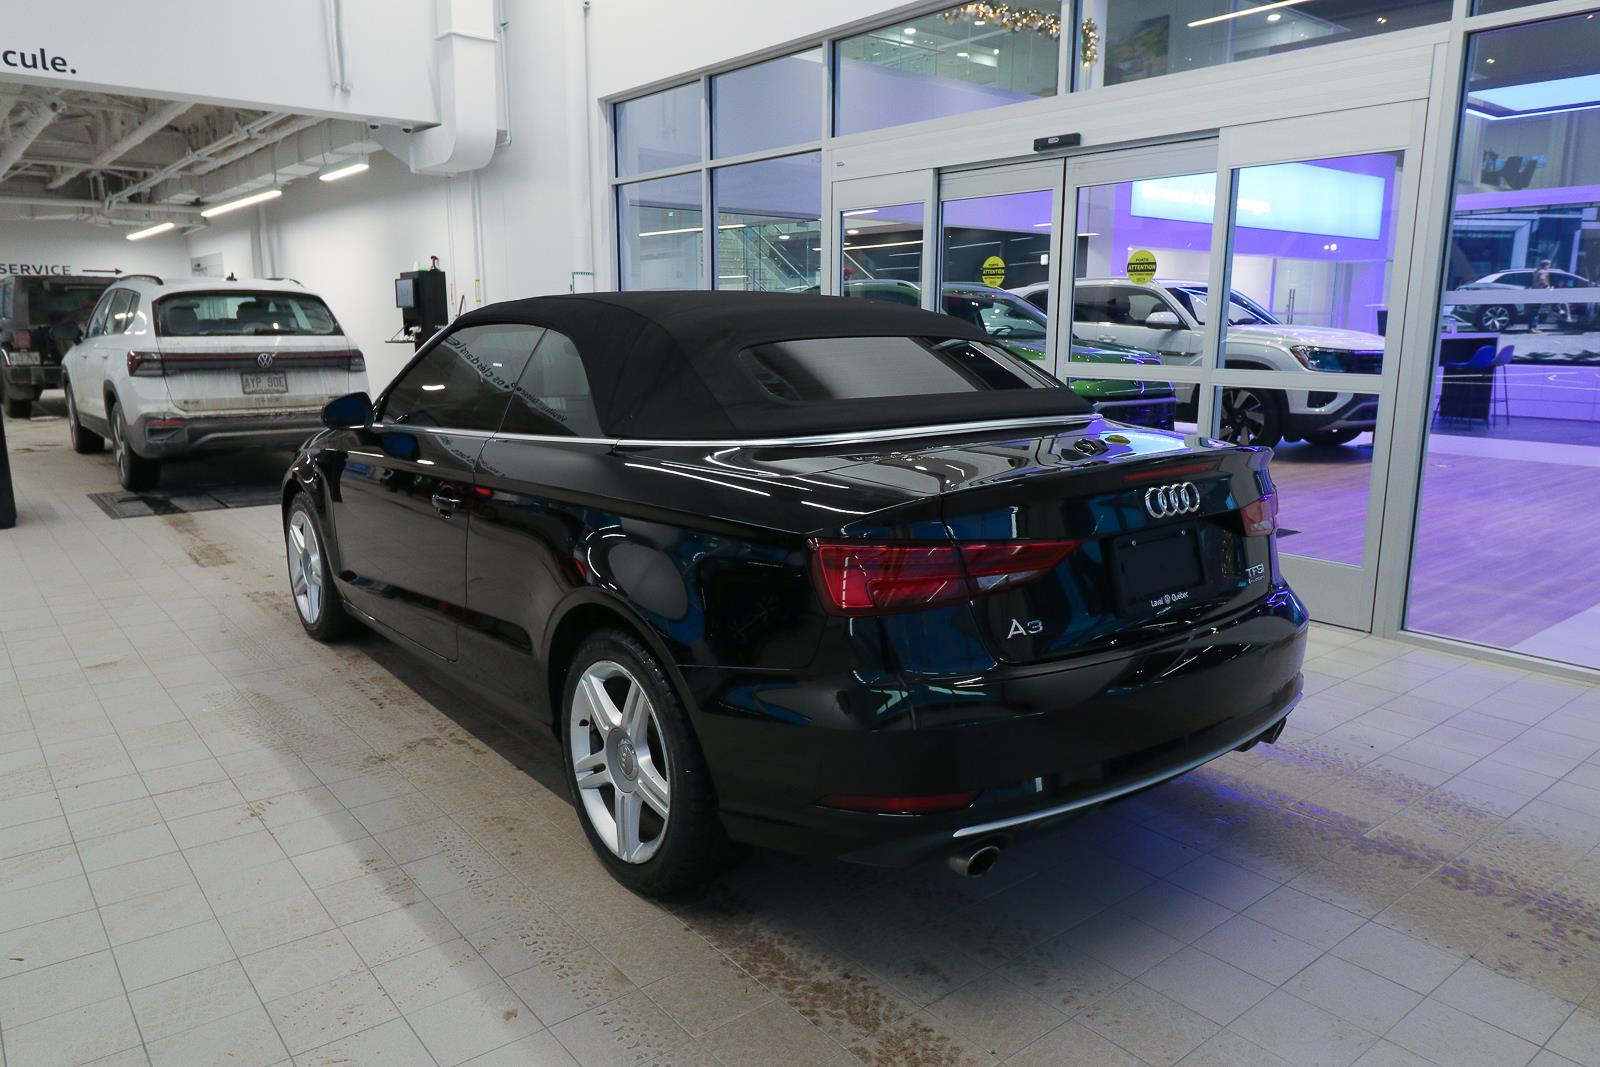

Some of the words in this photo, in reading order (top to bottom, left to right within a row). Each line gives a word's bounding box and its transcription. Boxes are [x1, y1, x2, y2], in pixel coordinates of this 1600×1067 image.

[2, 48, 77, 74] cule.
[0, 263, 71, 276] SERVICE
[1008, 619, 1043, 638] A3
